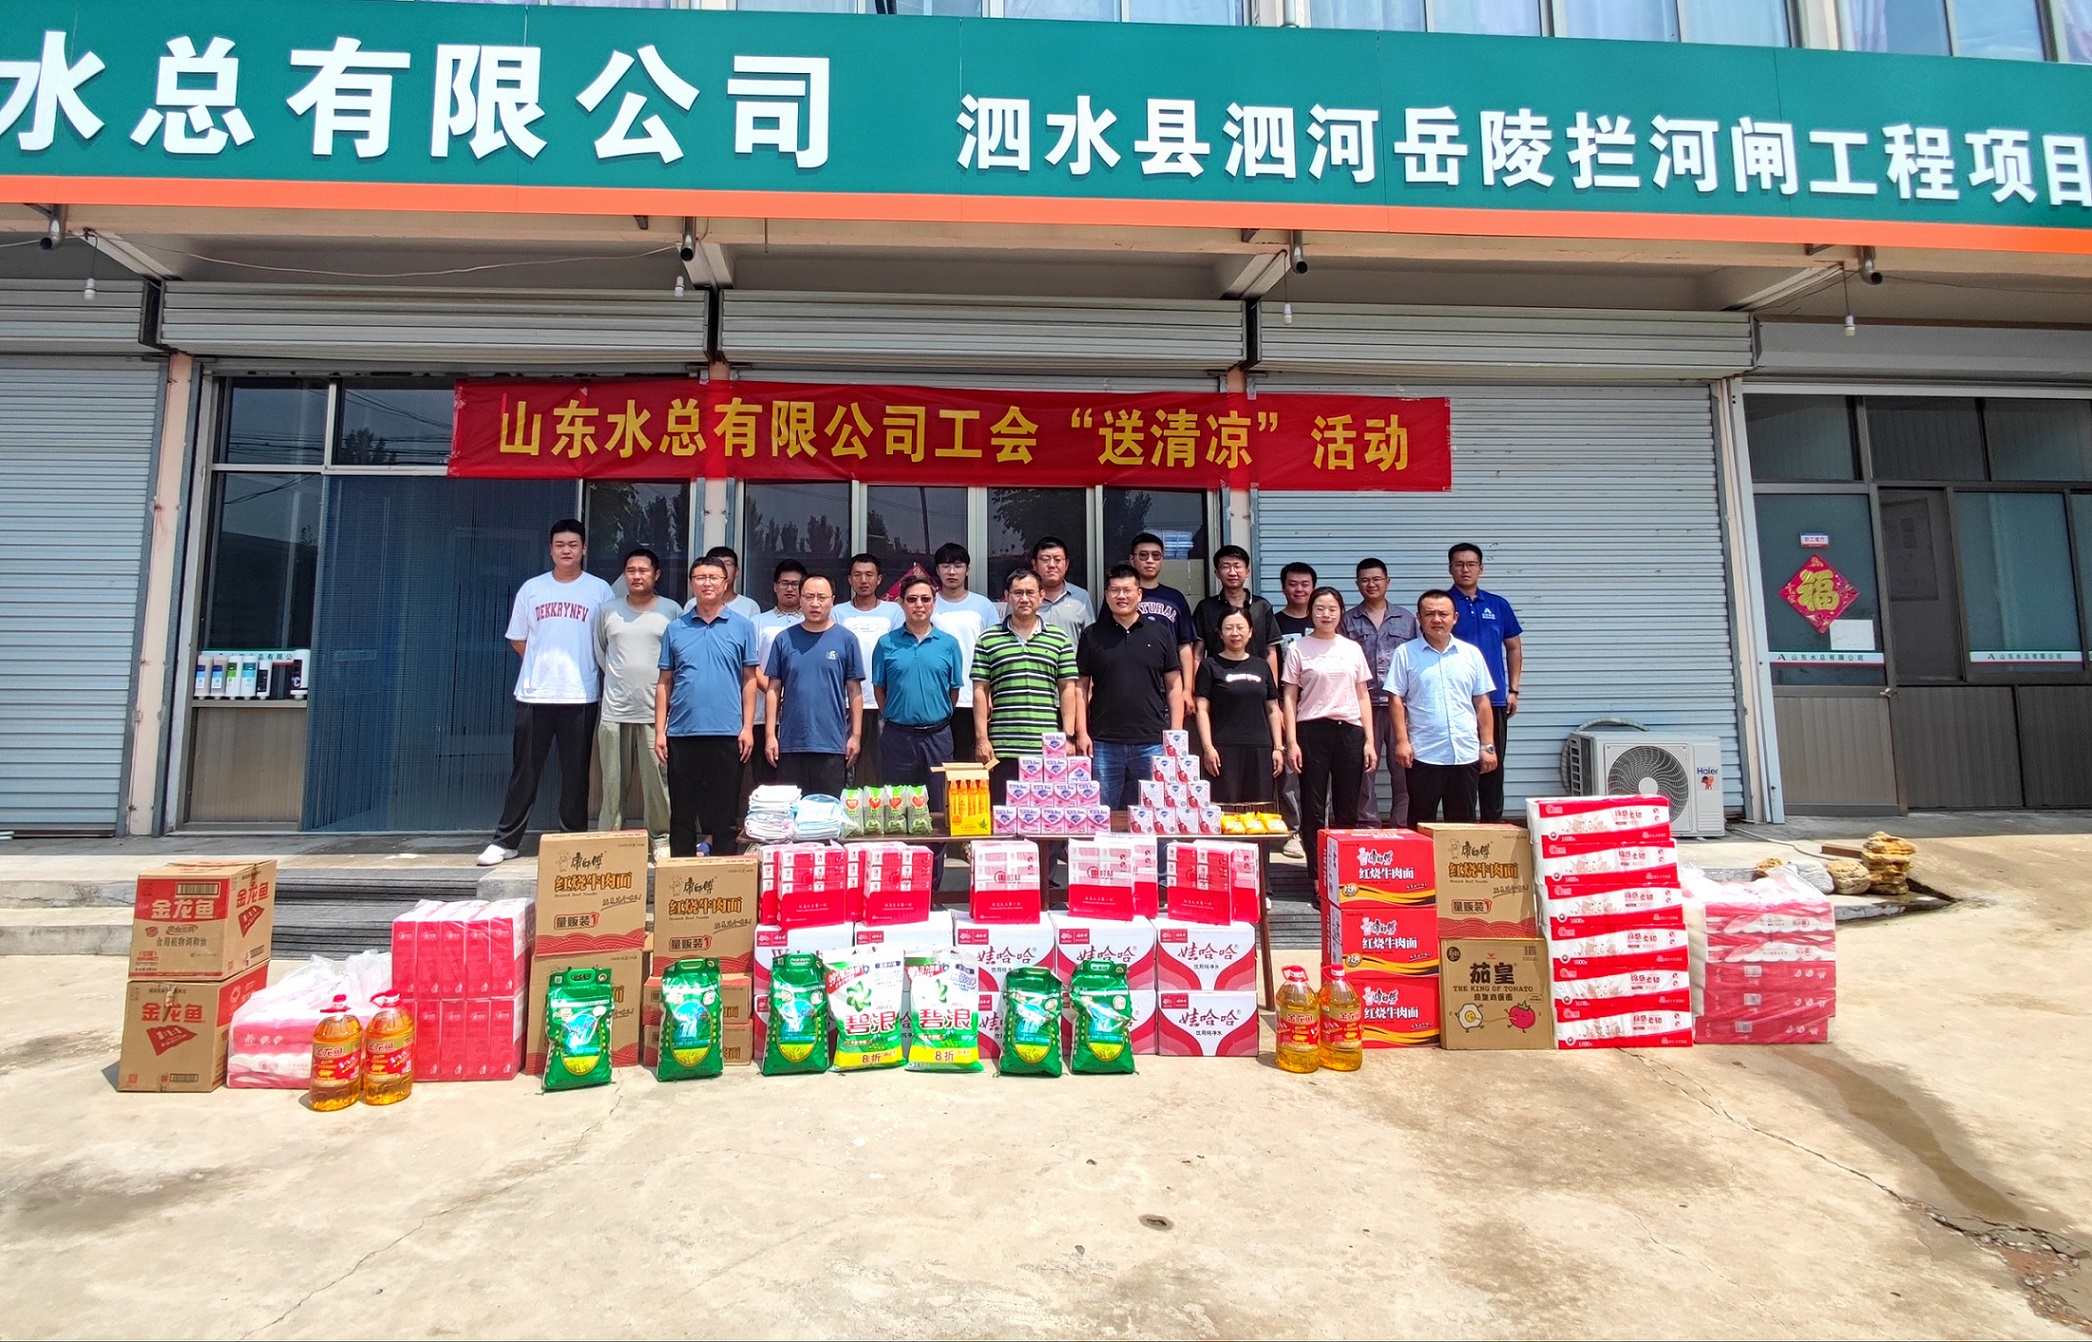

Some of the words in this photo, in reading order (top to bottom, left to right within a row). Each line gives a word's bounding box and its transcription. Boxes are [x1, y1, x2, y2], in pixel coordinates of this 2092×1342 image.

[0, 29, 831, 169] 水总有限公司
[956, 91, 2092, 208] 泗水县泗河岳陵拦河闸工程项目
[1796, 569, 1840, 612] 福
[1138, 601, 1177, 624] TURAL
[1696, 767, 1718, 775] Haier
[1461, 841, 1490, 858] 康师傅
[571, 852, 604, 871] 康师傅
[1449, 862, 1518, 879] 红烧牛肉面
[554, 872, 632, 892] 红烧牛肉面
[1358, 867, 1414, 880] 红烧牛肉面
[236, 881, 269, 909] 金龙鱼
[683, 877, 715, 895] 康师傅
[151, 899, 216, 920] 金龙鱼
[668, 897, 742, 916] 红烧牛肉面
[1453, 901, 1484, 912] 量贩装
[556, 916, 590, 928] 量贩装
[671, 938, 703, 950] 量贩装
[1177, 942, 1238, 961] 娃哈哈
[1362, 937, 1418, 950] 红烧牛肉面
[977, 946, 1036, 965] 娃哈哈
[1076, 945, 1136, 962] 娃哈哈
[1469, 962, 1515, 985] 茄皇
[141, 1002, 206, 1024] 金龙鱼
[919, 1008, 972, 1029] 碧浪
[1178, 1007, 1239, 1027] 娃哈哈
[1364, 1006, 1419, 1020] 红烧牛肉面
[845, 1011, 896, 1035] 碧浪
